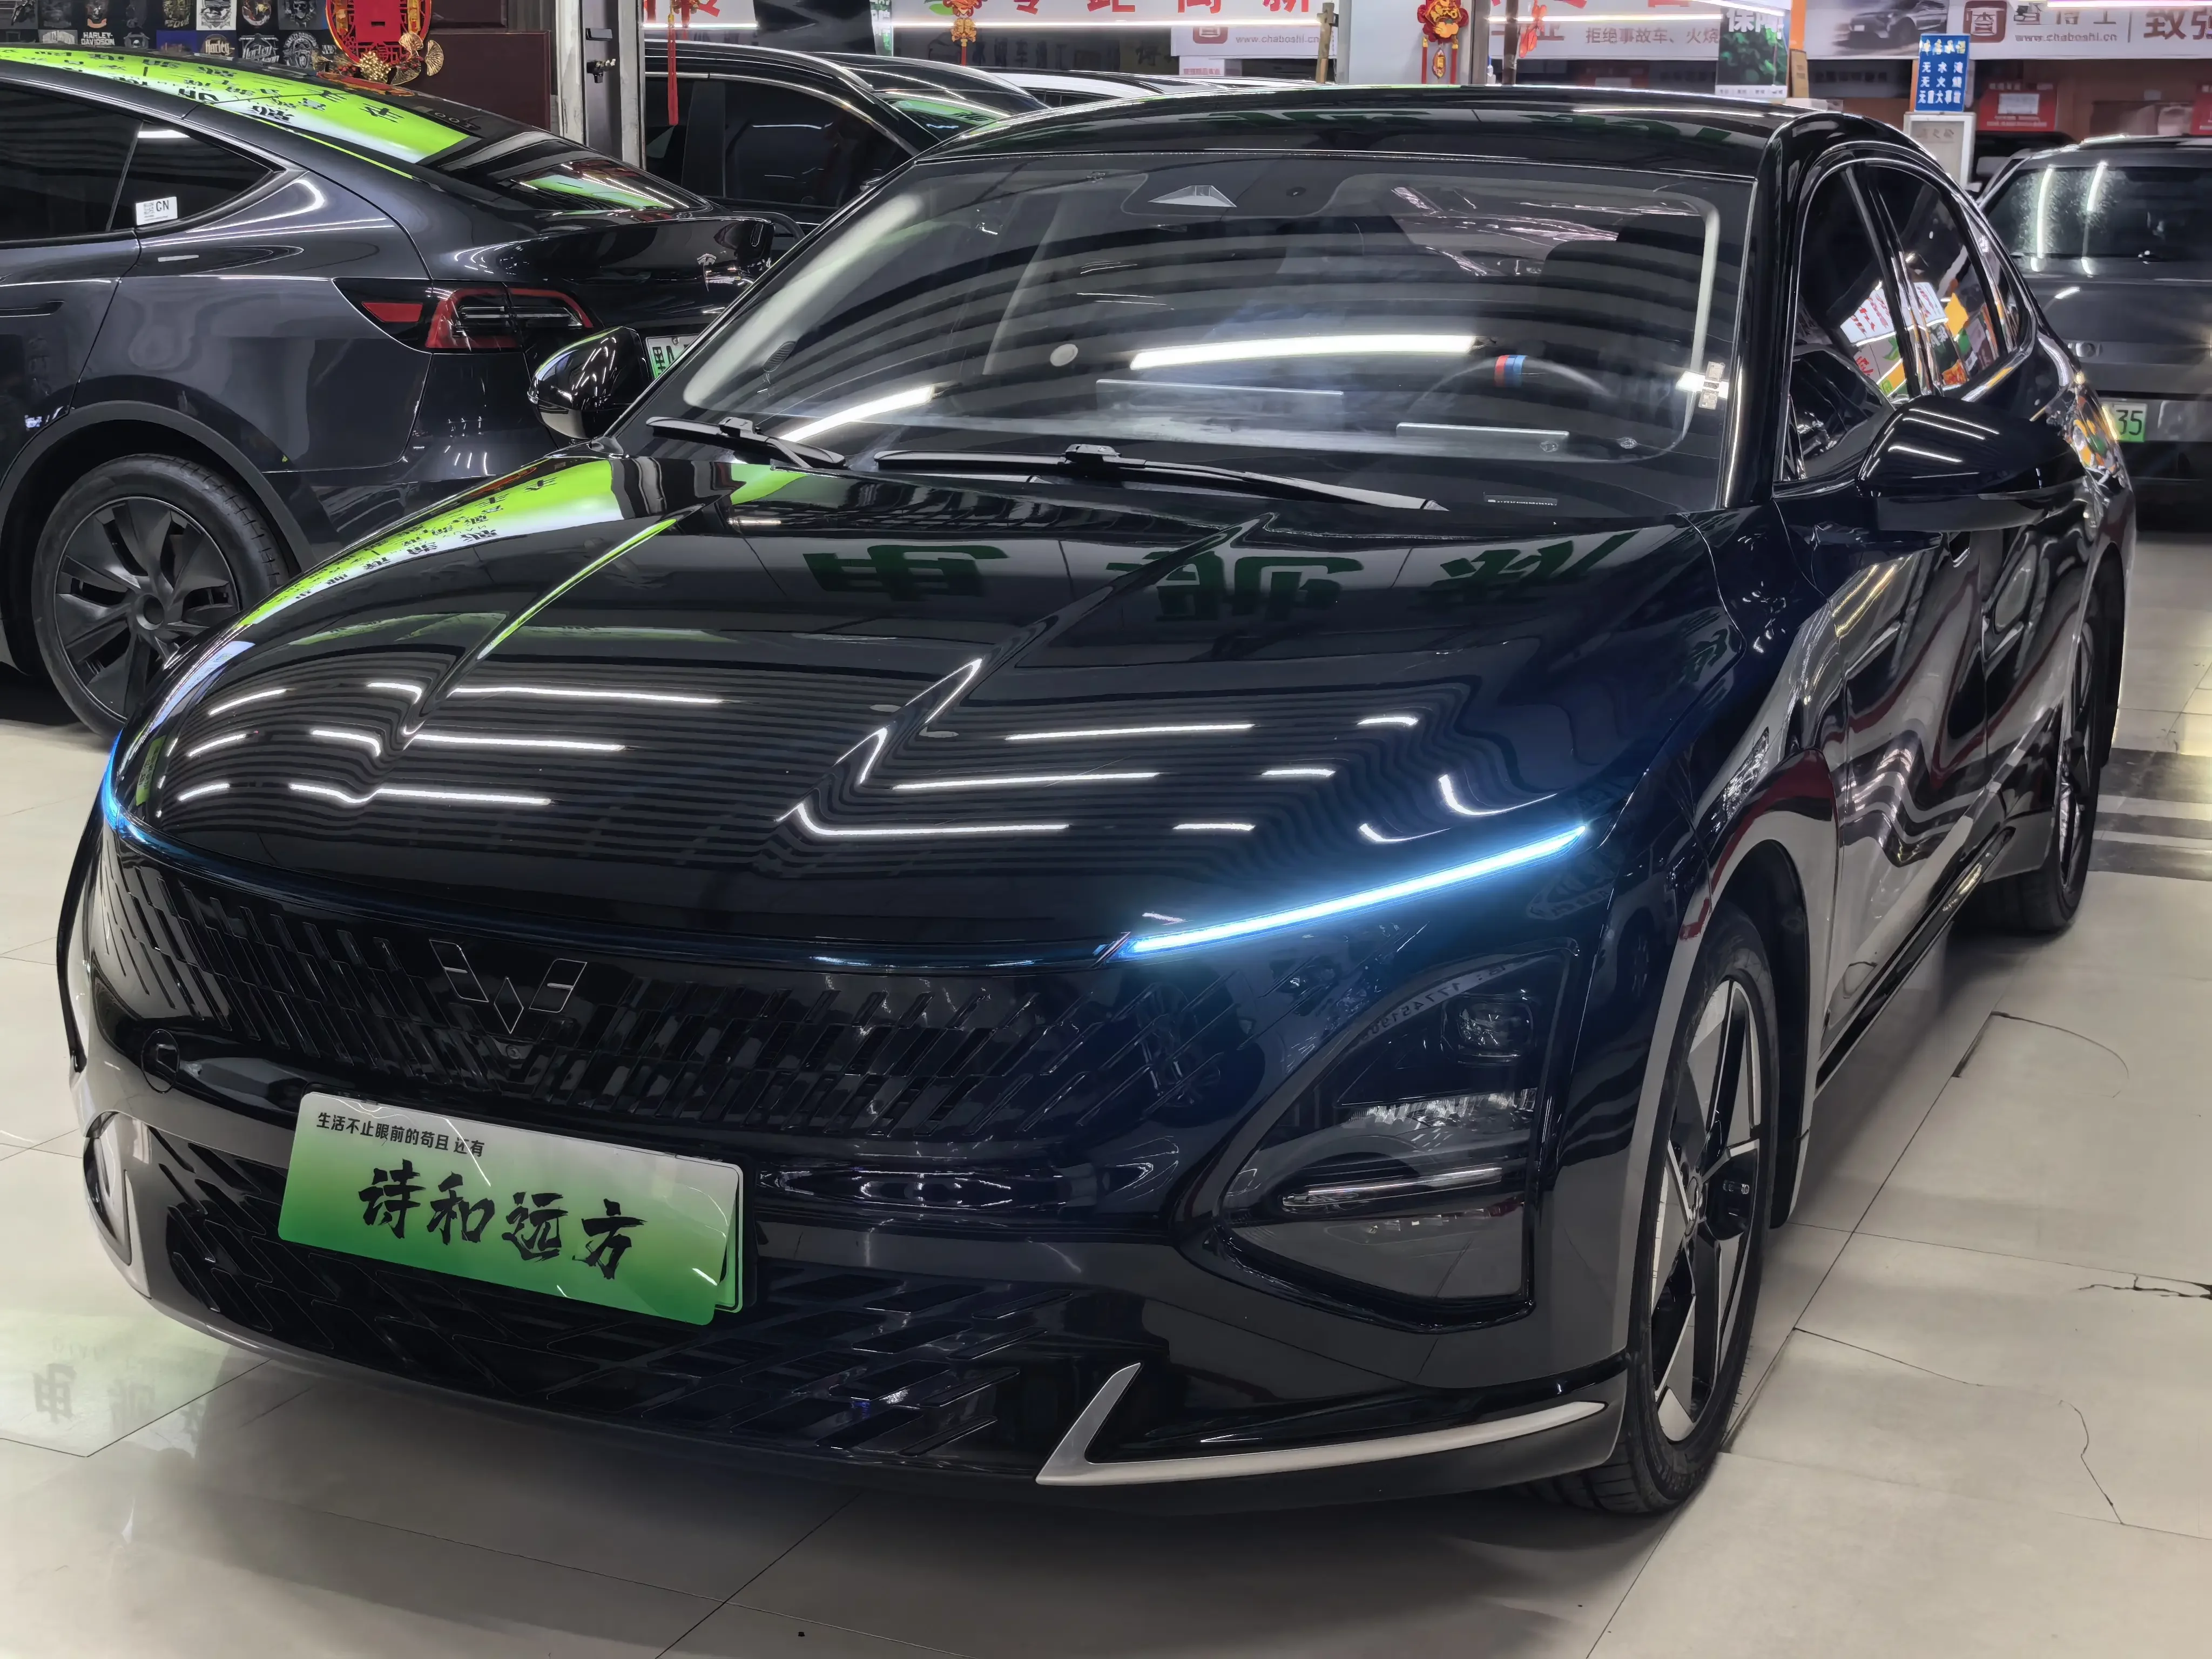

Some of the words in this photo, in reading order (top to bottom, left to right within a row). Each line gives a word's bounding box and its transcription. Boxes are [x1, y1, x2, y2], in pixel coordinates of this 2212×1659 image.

[156, 200, 169, 212] CN
[2115, 409, 2143, 436] 35
[316, 1112, 449, 1151] 生活不止眼前的苟且
[453, 1136, 485, 1157] 还有
[358, 1158, 648, 1280] 诗和远方
